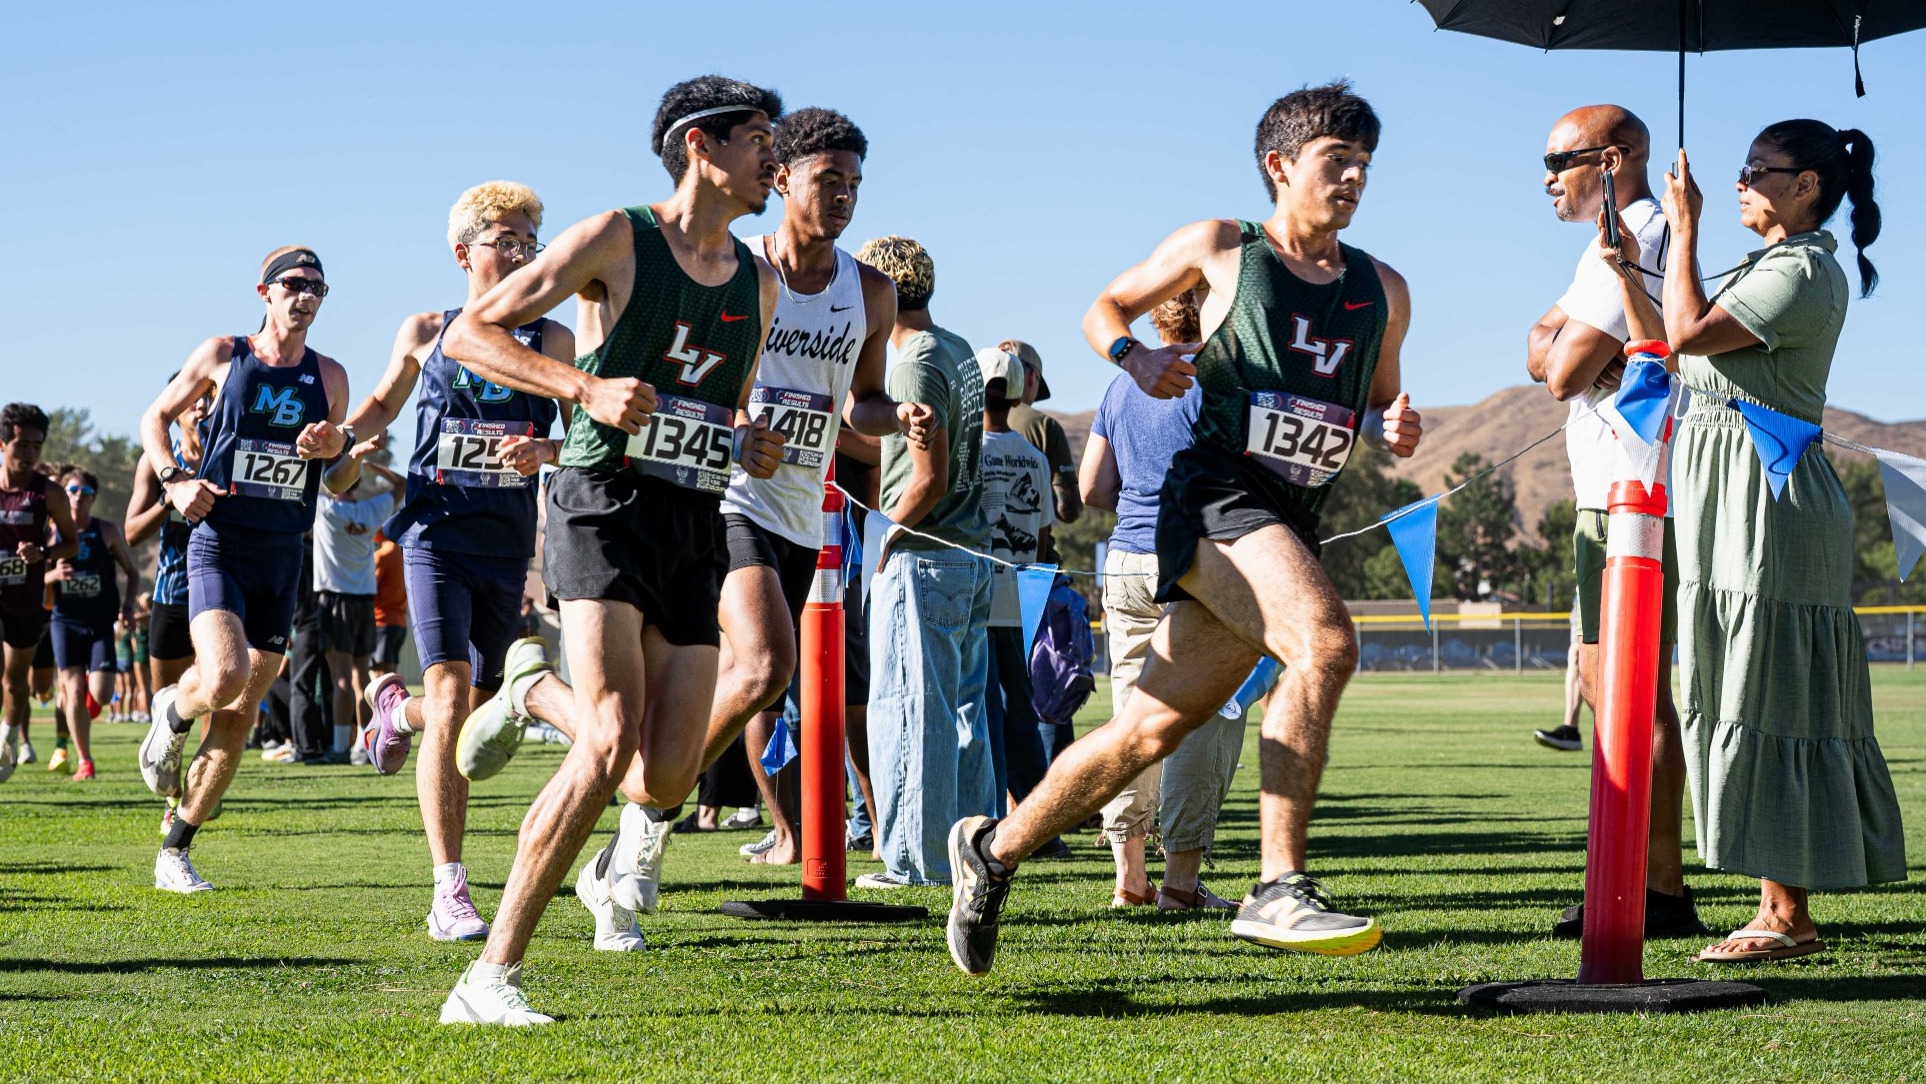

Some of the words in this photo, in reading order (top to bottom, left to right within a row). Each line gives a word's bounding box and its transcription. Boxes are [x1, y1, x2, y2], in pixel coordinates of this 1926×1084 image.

[663, 320, 727, 387] LV
[762, 317, 856, 365] iverside
[1287, 312, 1354, 378] LV
[249, 383, 306, 428] MB
[452, 436, 503, 469] 125
[643, 415, 732, 469] 1345
[1262, 412, 1350, 469] 1342
[243, 454, 307, 486] 1267
